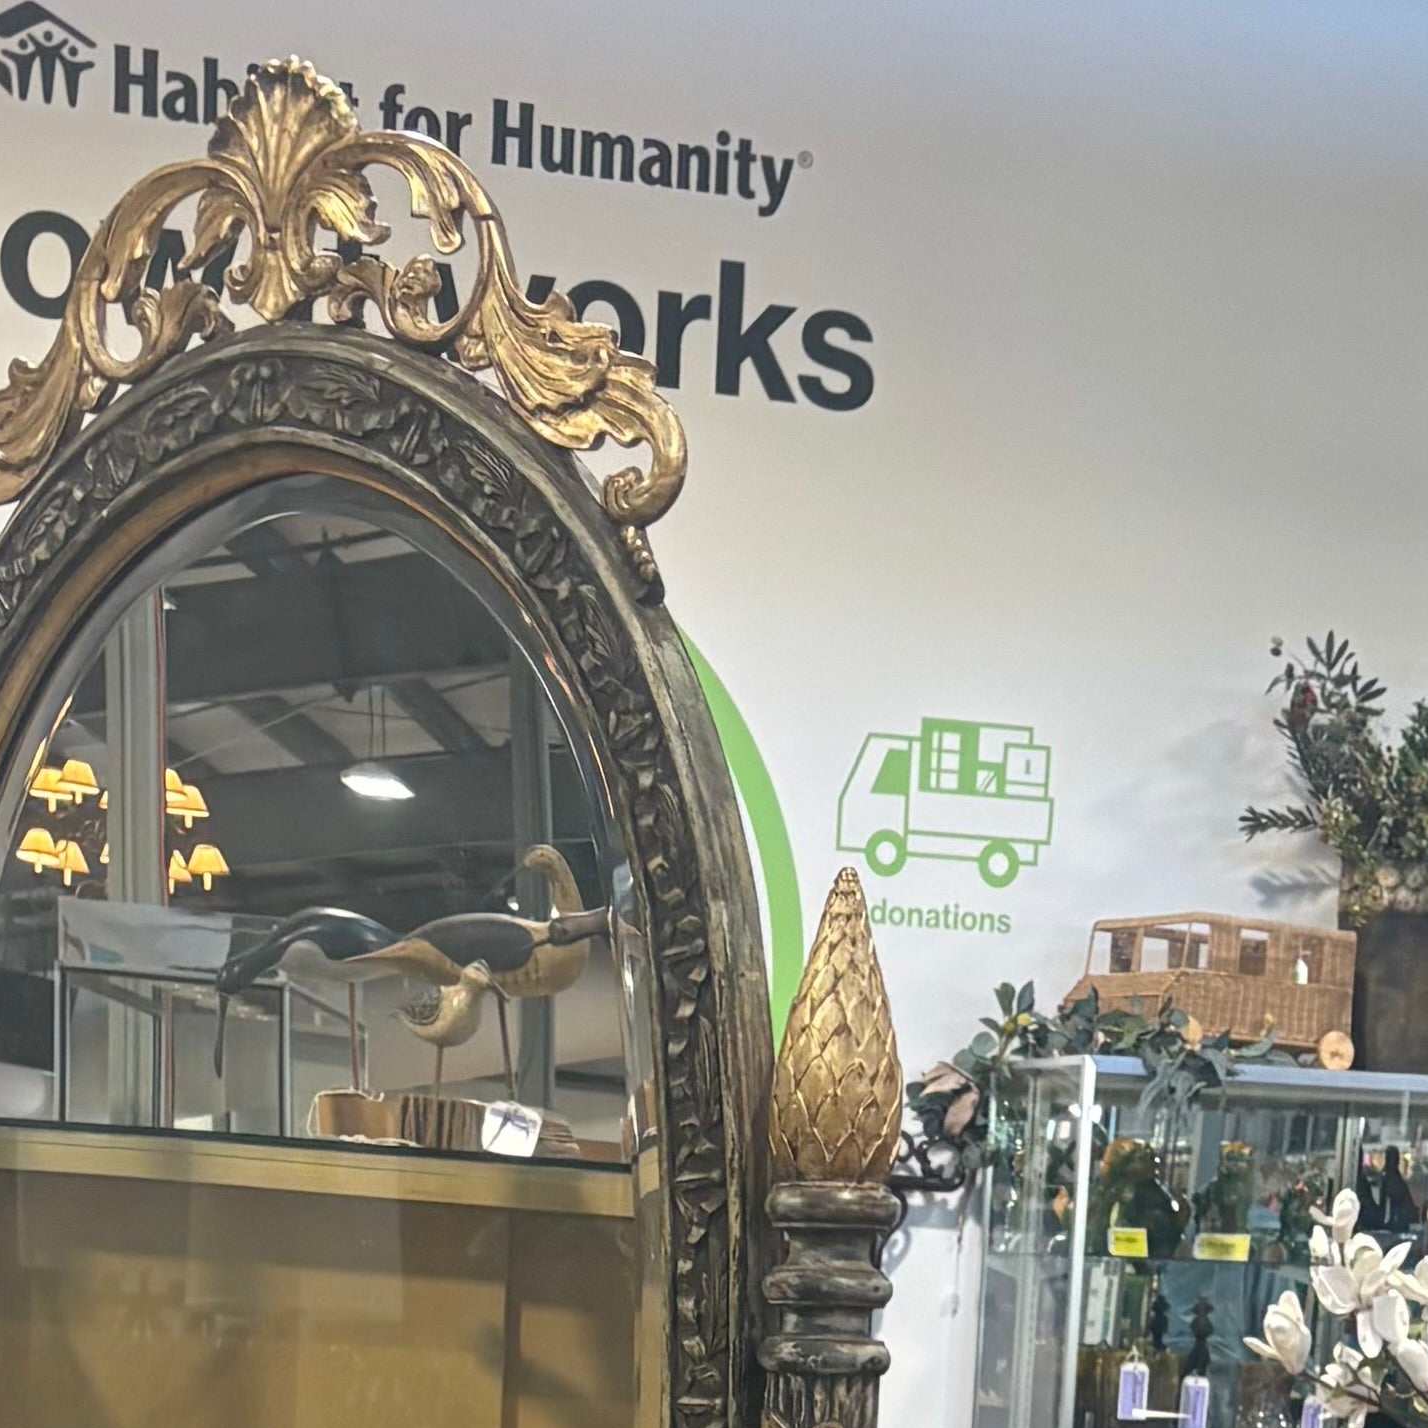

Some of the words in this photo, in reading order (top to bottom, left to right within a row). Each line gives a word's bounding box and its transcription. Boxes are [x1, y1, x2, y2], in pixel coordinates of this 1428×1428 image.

[379, 84, 473, 157] for
[433, 258, 875, 412] orks
[870, 898, 1012, 934] donations
